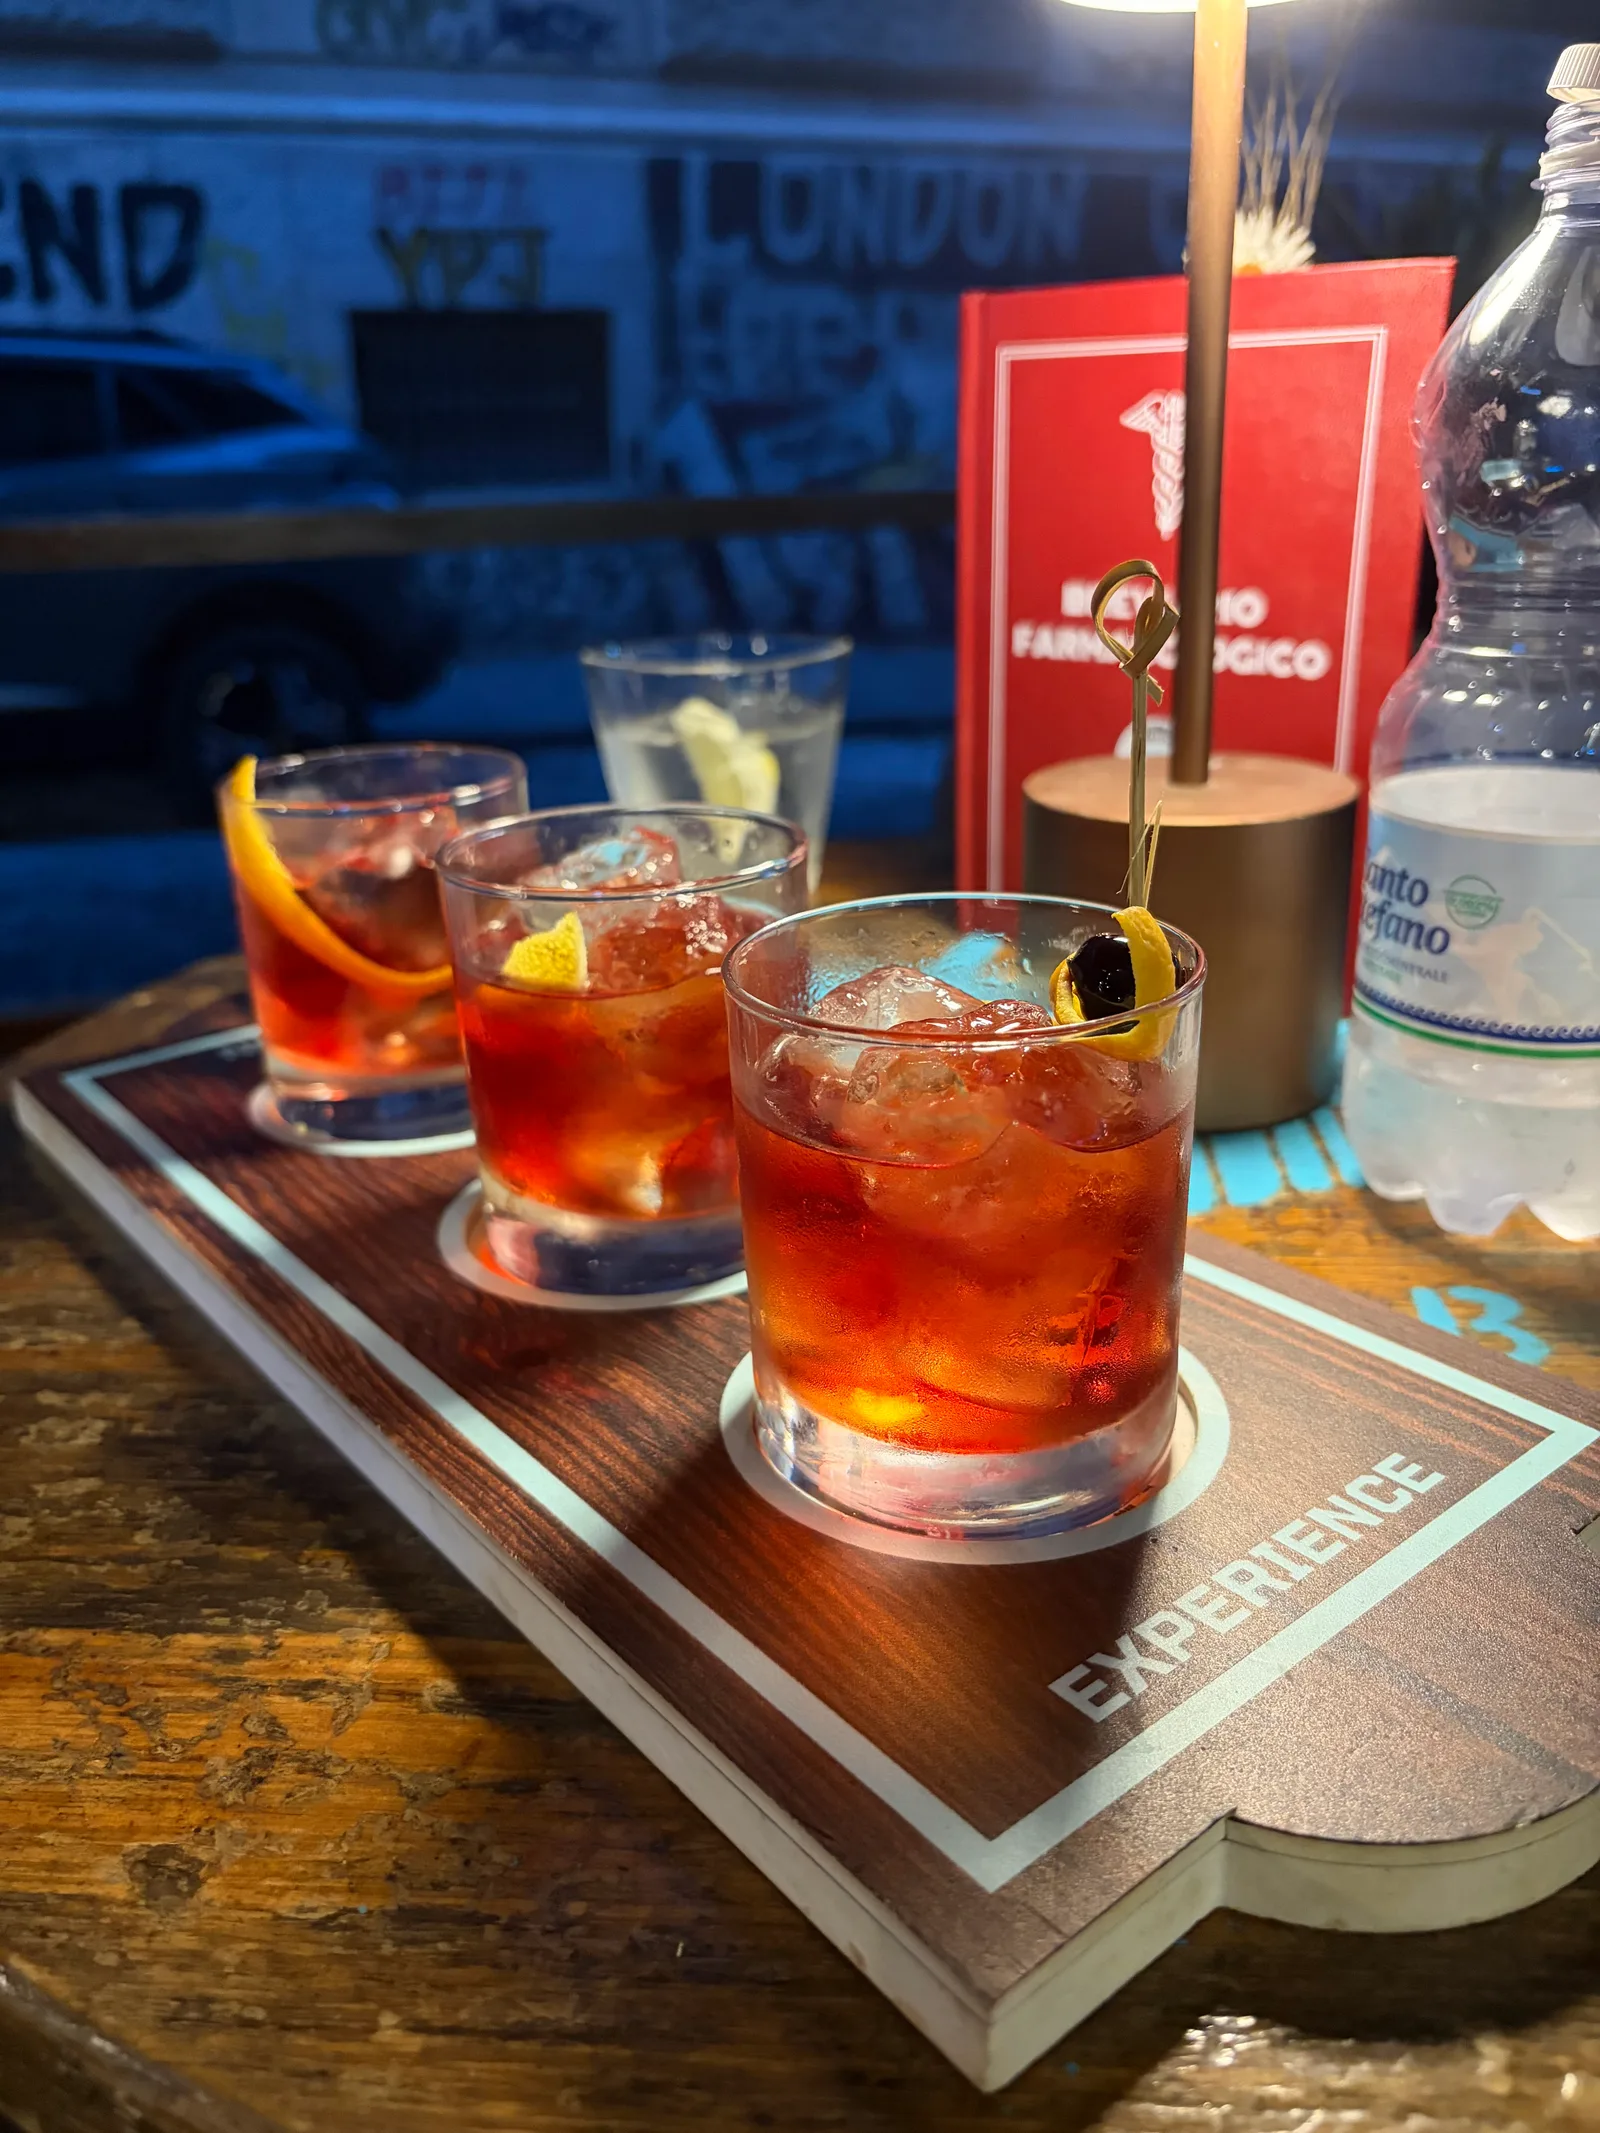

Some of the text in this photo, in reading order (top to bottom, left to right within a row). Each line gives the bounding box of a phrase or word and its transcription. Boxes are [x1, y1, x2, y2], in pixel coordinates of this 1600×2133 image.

[684, 150, 1088, 272] LONDON
[0, 176, 206, 312] ND
[1061, 579, 1269, 628] BEVIIO
[1011, 621, 1332, 681] FARMAGICO
[1365, 862, 1429, 908] anto
[1363, 900, 1450, 955] efano
[1048, 1453, 1445, 1723] EXPERIENCE
